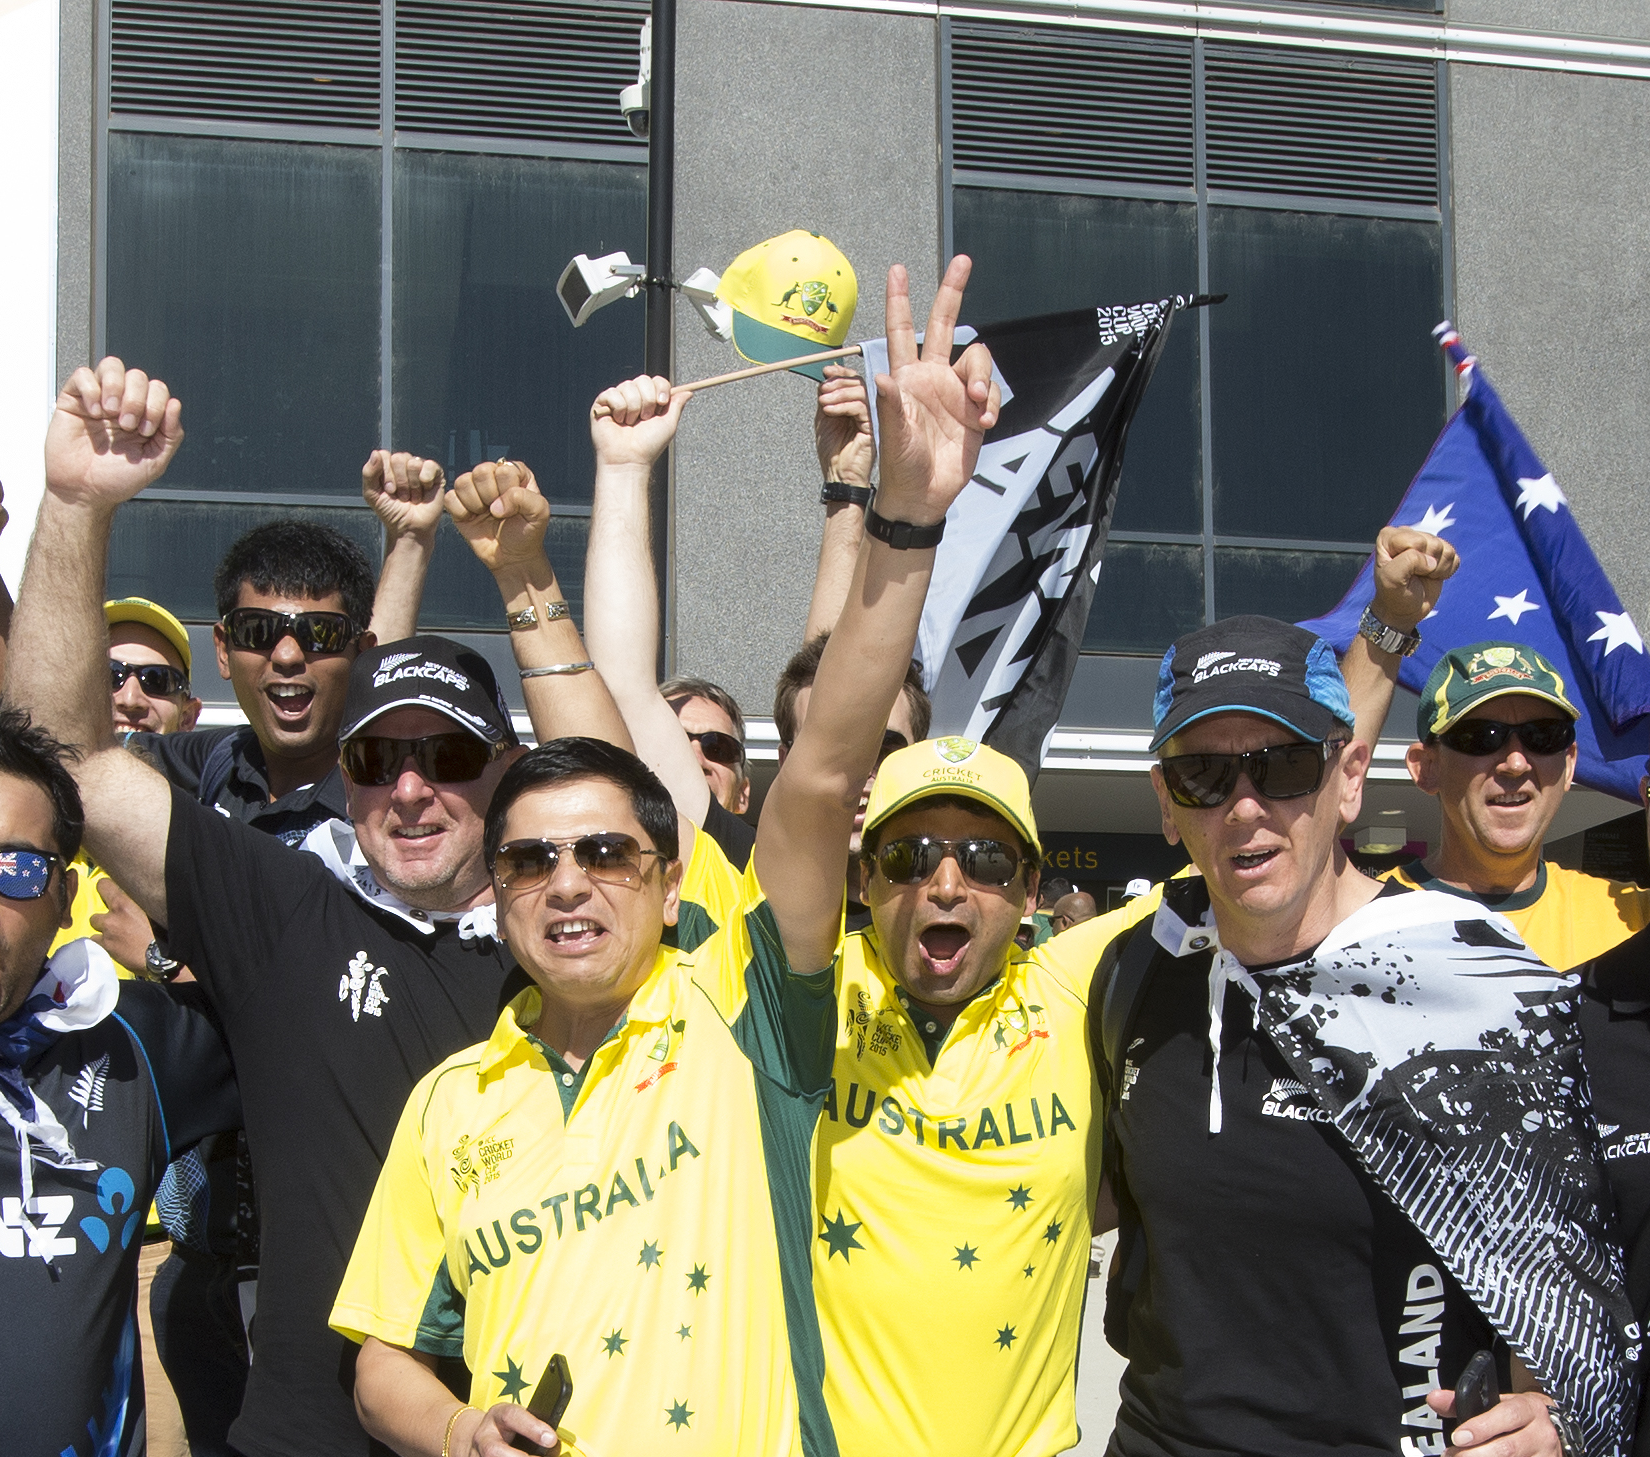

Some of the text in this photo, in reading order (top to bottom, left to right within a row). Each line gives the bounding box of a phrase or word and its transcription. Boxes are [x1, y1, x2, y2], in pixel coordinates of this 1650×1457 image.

[373, 665, 468, 692] BLACKCAPS
[1193, 662, 1281, 684] BLACKCAPS
[922, 766, 982, 781] CRICKET
[478, 1138, 514, 1157] CRICKET
[481, 1149, 513, 1166] WORLD
